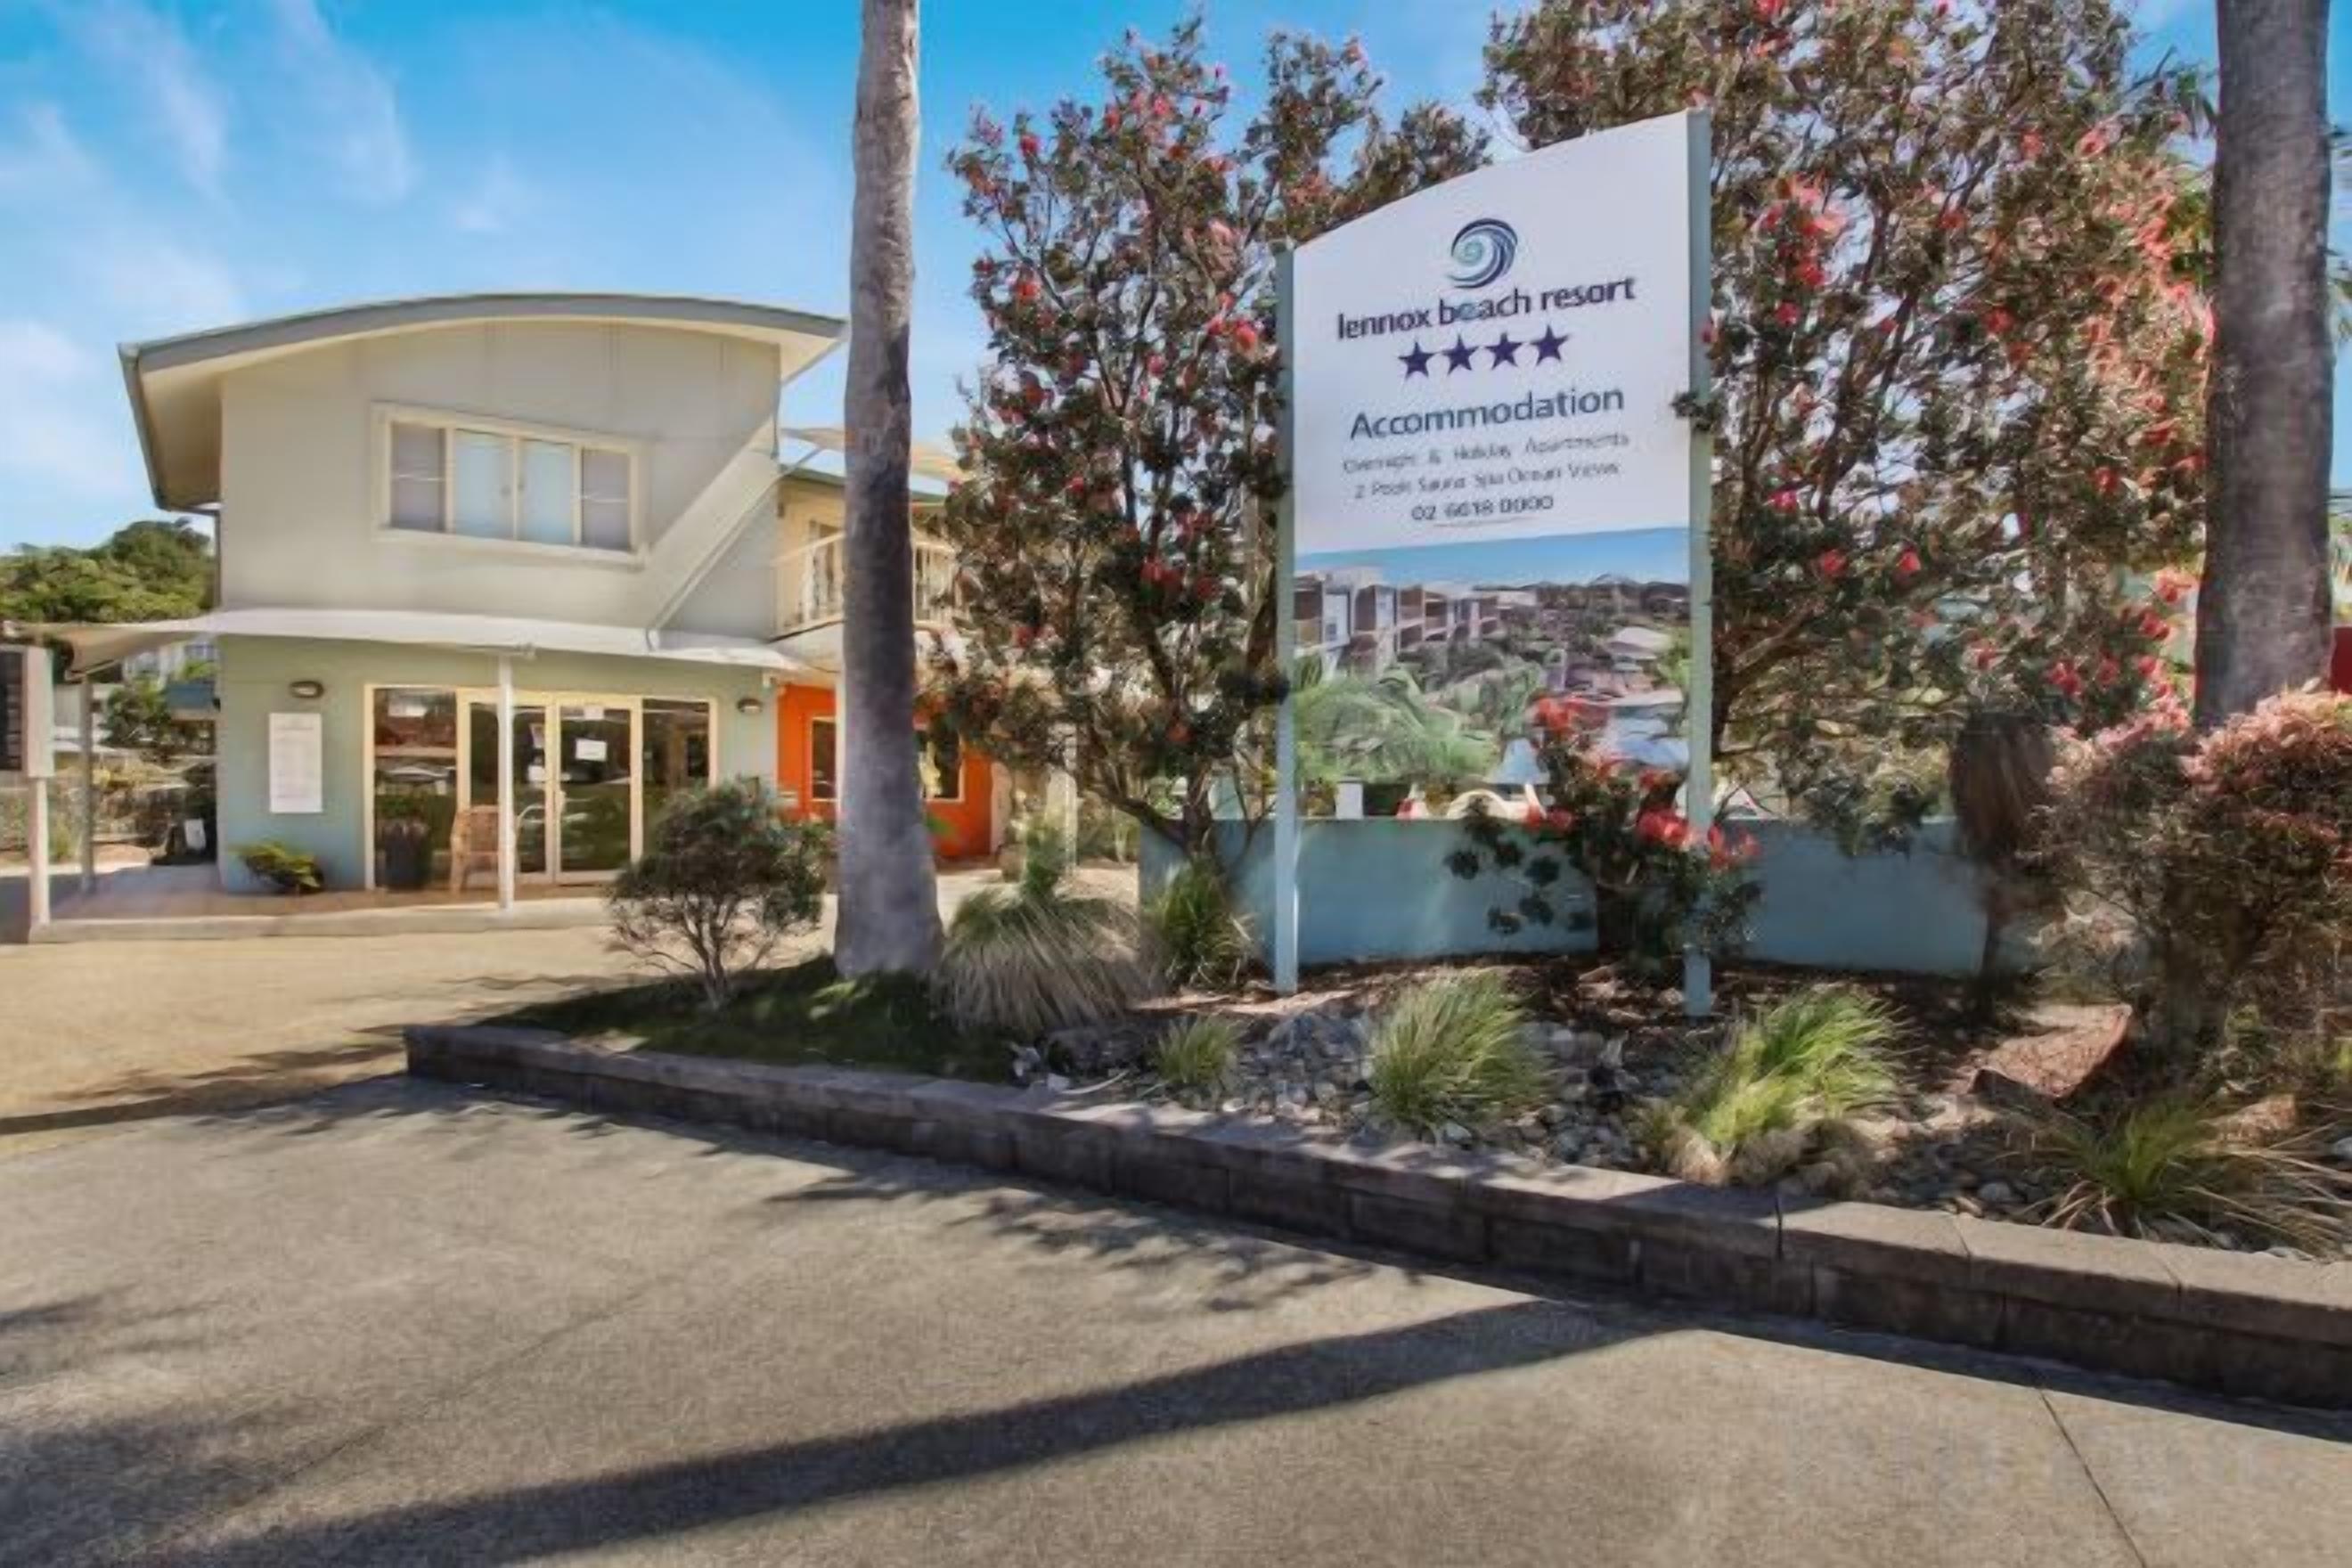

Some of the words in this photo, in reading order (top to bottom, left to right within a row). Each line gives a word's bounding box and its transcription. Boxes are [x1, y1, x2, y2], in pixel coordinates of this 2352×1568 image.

[1338, 312, 1432, 339] lennox
[1439, 289, 1531, 326] beach
[1541, 277, 1636, 310] resort
[1351, 388, 1624, 439] Accommodation
[1411, 505, 1436, 520] 02
